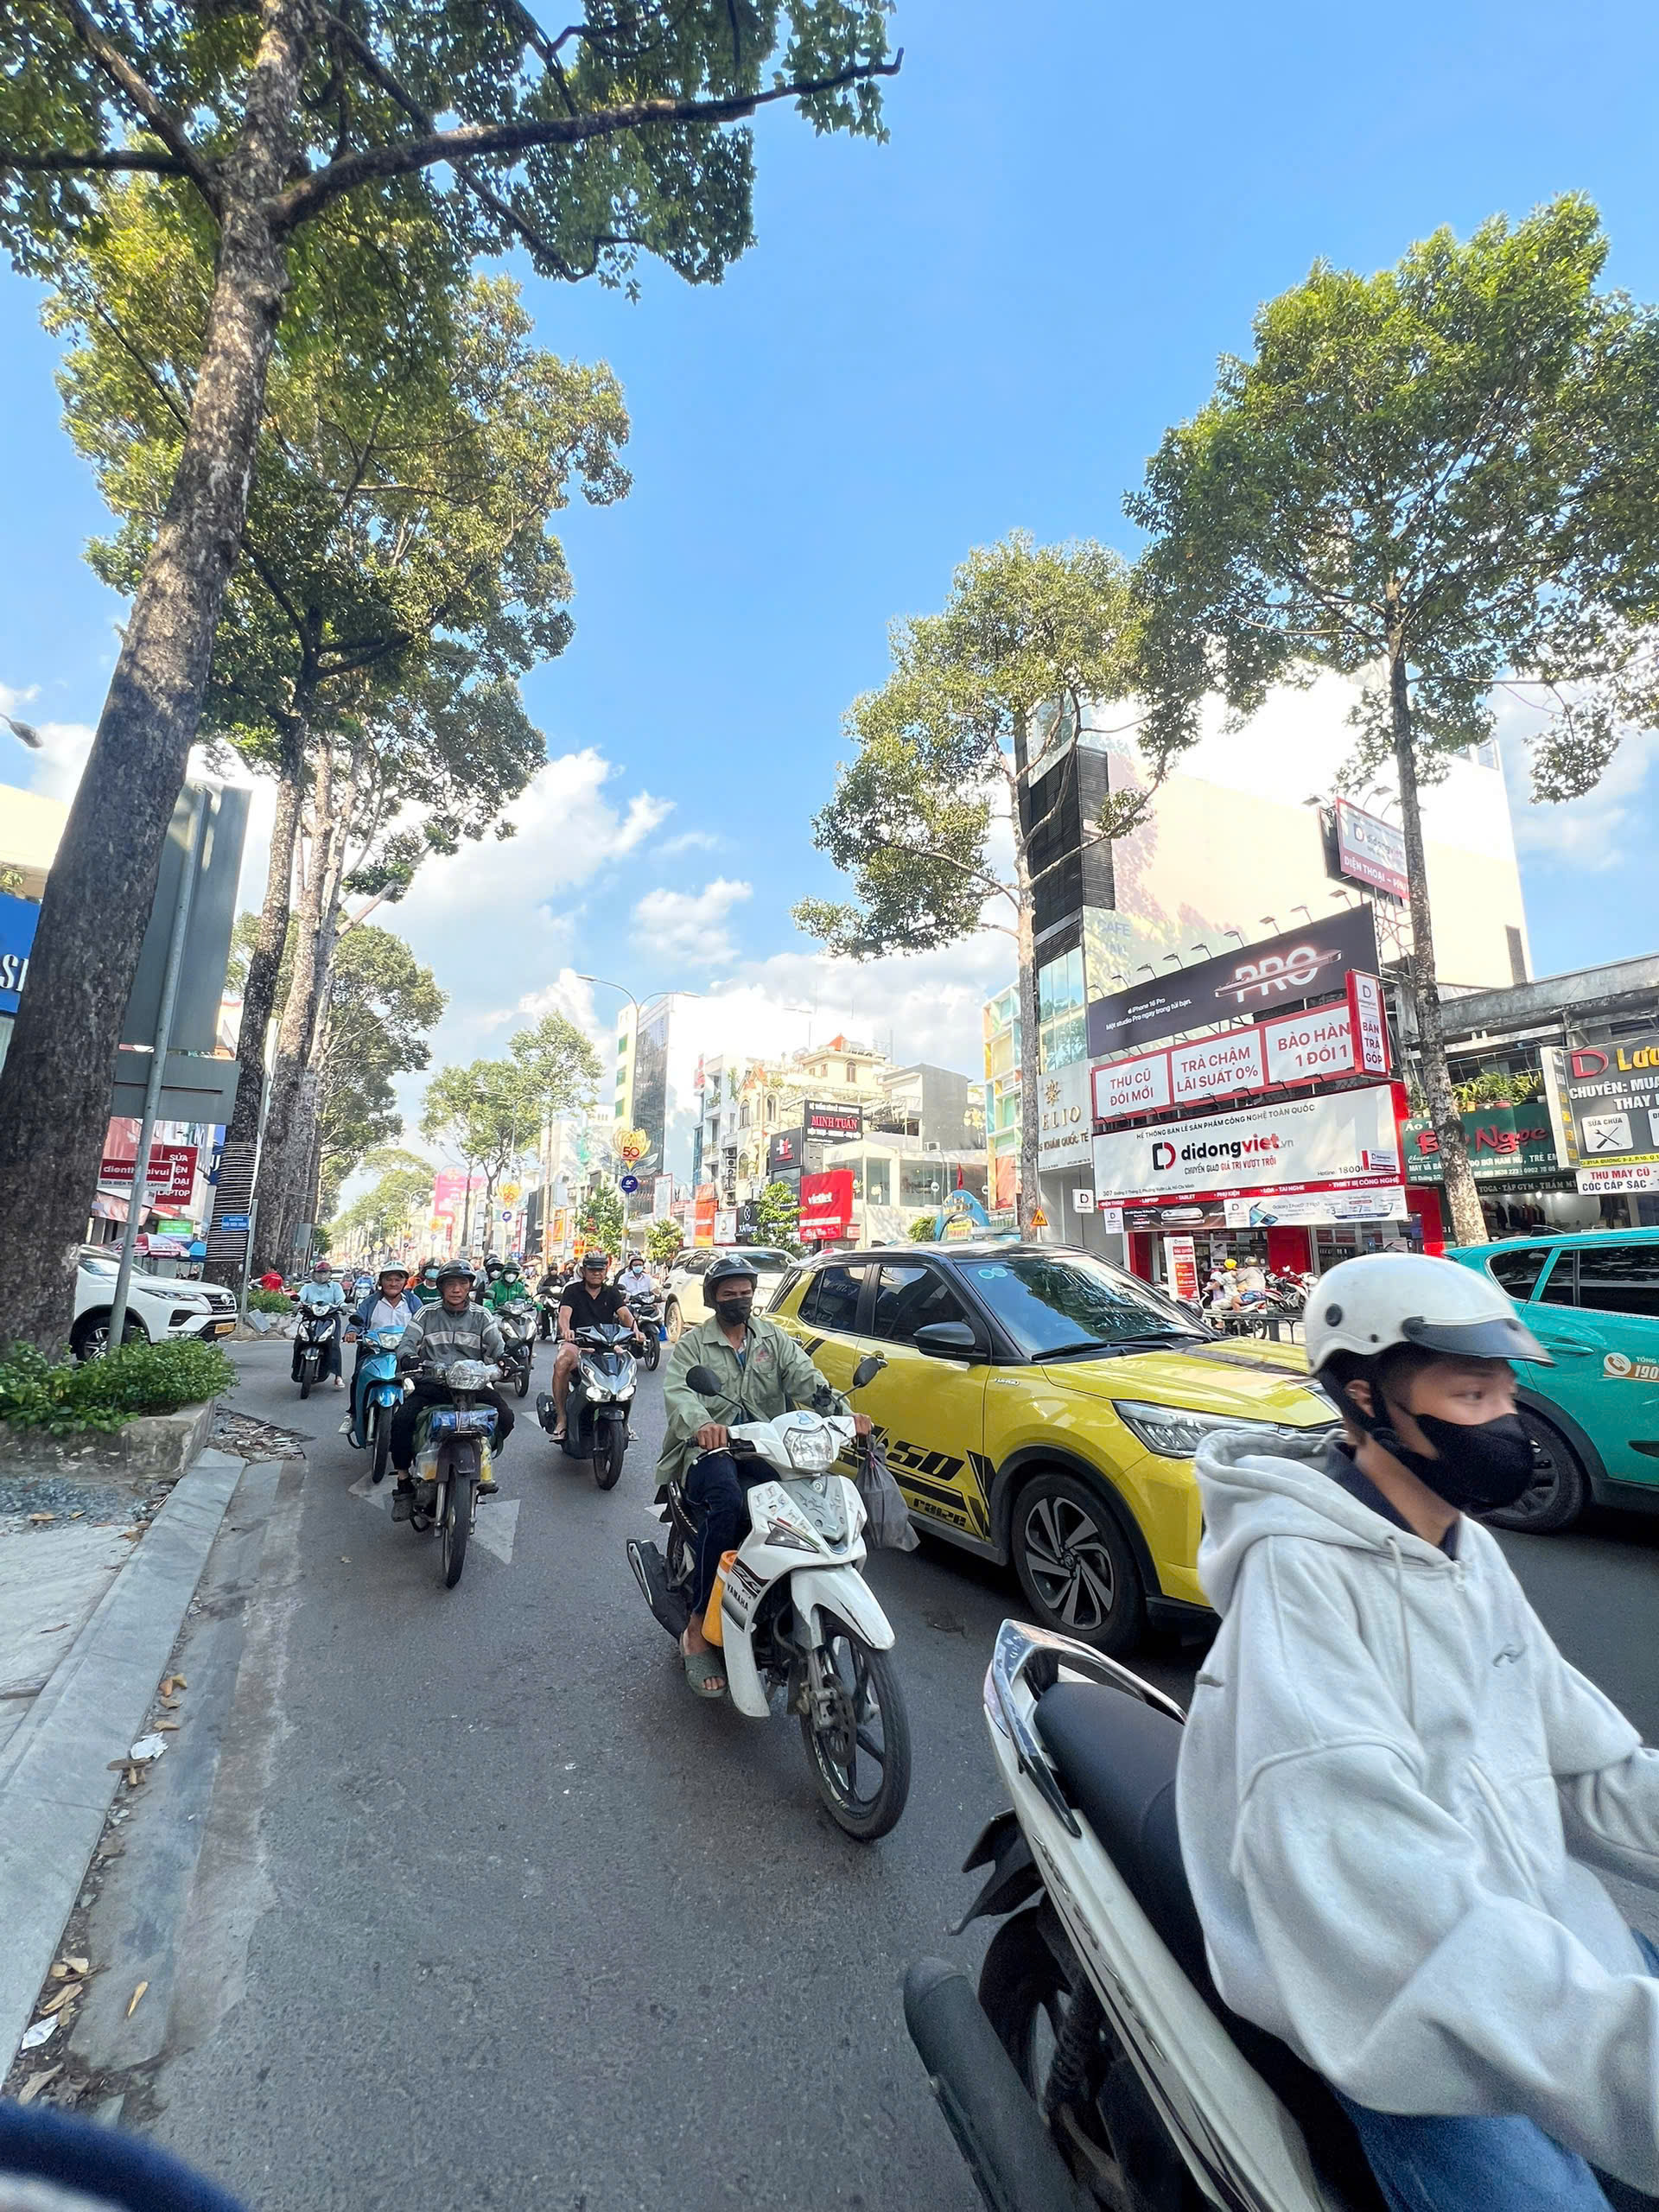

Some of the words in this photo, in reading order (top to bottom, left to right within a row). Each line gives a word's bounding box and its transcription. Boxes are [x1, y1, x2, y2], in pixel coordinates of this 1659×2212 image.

[1363, 862, 1385, 882] THOẠI
[1234, 946, 1319, 1003] PRO
[1156, 997, 1166, 1006] Pro
[1116, 1018, 1132, 1027] studio
[1132, 1014, 1141, 1022] Pro
[1141, 1010, 1155, 1020] ngay
[1155, 1006, 1171, 1015] trong
[1363, 1020, 1379, 1034] BÁN
[1209, 1046, 1250, 1066] CHẬM
[1295, 1054, 1302, 1067] 1
[1306, 1044, 1336, 1065] ĐỔI
[1339, 1044, 1347, 1058] 1
[1366, 1051, 1382, 1065] GÓP
[1109, 1074, 1132, 1090] THU
[1135, 1068, 1151, 1084] CŨ
[1177, 1077, 1196, 1092] LÃI
[1198, 1068, 1232, 1088] SUẤT
[1236, 1065, 1258, 1079] 0%
[1131, 1085, 1154, 1102] MỚI
[1569, 1081, 1628, 1100] CHUYÊN:
[1614, 1094, 1651, 1110] THAY
[811, 1115, 834, 1128] MINH
[835, 1115, 859, 1129] TUẤN
[1041, 1106, 1082, 1131] ELIO
[1145, 1128, 1166, 1139] THỐNG
[1166, 1125, 1180, 1135] BÁN
[1224, 1114, 1246, 1125] CÔNG
[1246, 1111, 1268, 1123] NGHỆ
[1268, 1107, 1290, 1119] TOÀN
[1291, 1103, 1316, 1116] QUỐC
[1405, 1120, 1423, 1132] Áo
[1181, 1133, 1294, 1161] didongviet.vn
[1475, 1125, 1548, 1154] Ngọc
[168, 1152, 188, 1162] SỬA
[623, 1146, 640, 1157] 50
[1206, 1163, 1219, 1172] GIAO
[1220, 1160, 1231, 1171] GIÁ
[1495, 1156, 1511, 1165] NAM
[1358, 1176, 1379, 1186] CÔNG
[1380, 1175, 1400, 1185] NGHỆ
[1591, 1171, 1609, 1180] THU
[1636, 1167, 1650, 1177] CŨ
[173, 1178, 190, 1186] OẠI
[1502, 1182, 1516, 1192] TẬP
[1627, 1179, 1647, 1191] SẠC
[727, 1583, 748, 1611] YAMAHA
